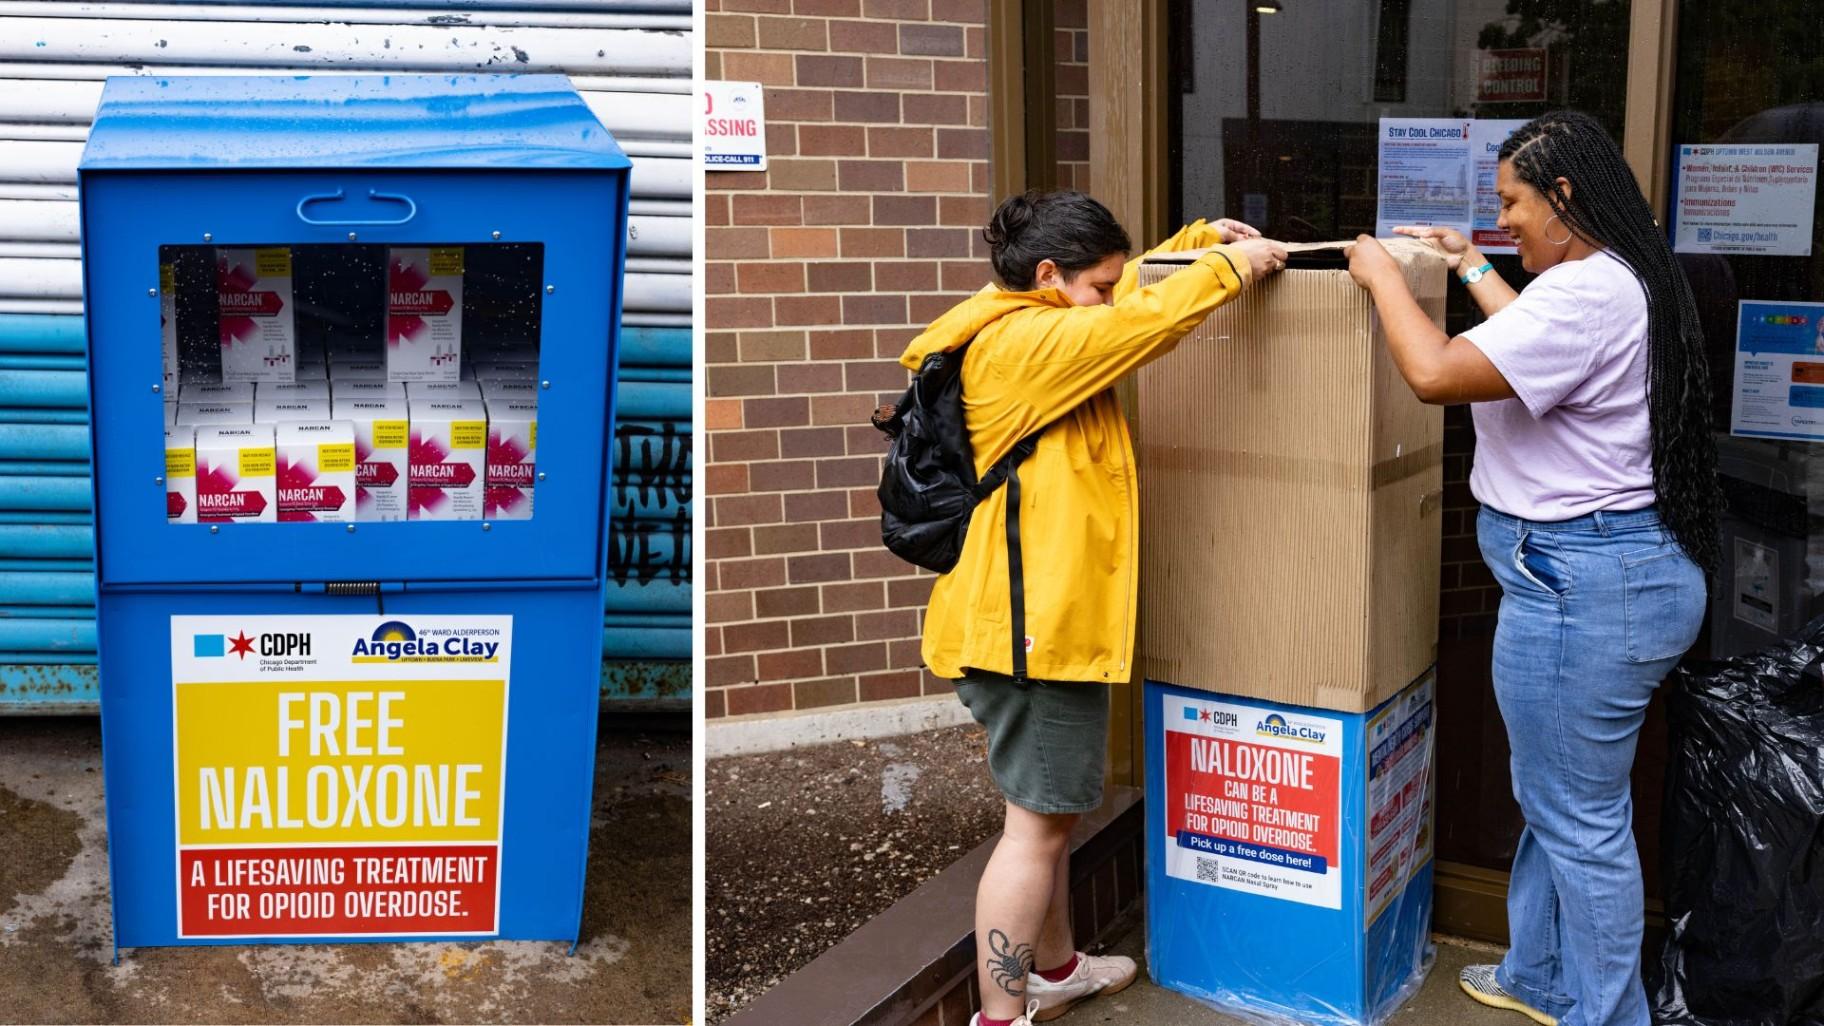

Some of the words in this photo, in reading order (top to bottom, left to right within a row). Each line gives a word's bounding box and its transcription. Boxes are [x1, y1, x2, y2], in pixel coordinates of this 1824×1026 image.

[1483, 57, 1541, 73] BLEEDING
[1483, 78, 1538, 95] CONTROL
[705, 119, 757, 136] SSING
[1786, 165, 1814, 174] Services
[1684, 199, 1736, 207] Immunizations
[1713, 230, 1778, 242] Chicago.gov/health
[219, 293, 263, 306] NARCAN
[390, 292, 433, 305] NARCAN
[356, 464, 377, 477] CAN
[410, 464, 454, 477] NARCAN
[488, 464, 533, 478] NARCAN
[199, 493, 245, 507] NARCAN
[278, 488, 324, 502] NARCAN
[260, 632, 311, 657] CDPH
[352, 637, 439, 660] Angela
[443, 637, 499, 659] Clay
[278, 691, 406, 757] FREE
[1213, 710, 1238, 727] CDPH
[1256, 720, 1297, 737] Angela
[1299, 726, 1326, 743] Clay
[1190, 737, 1314, 790] NALOXONE
[199, 764, 483, 830] NALOXONE
[1224, 780, 1248, 800] CAN
[1252, 785, 1267, 803] BE
[1269, 788, 1279, 805] A
[1184, 793, 1248, 820] LIFESAVING
[1251, 804, 1320, 832] TREATMENT
[1186, 812, 1208, 832] FOR
[1211, 817, 1249, 840] OPIOID
[1253, 825, 1317, 853] OVERDOSE.
[1190, 836, 1212, 850] Pick
[1214, 842, 1227, 854] up
[1229, 845, 1235, 854] a
[1237, 844, 1257, 858] free
[1259, 848, 1284, 863] dose
[1286, 852, 1312, 869] here!
[191, 860, 206, 887] A
[215, 858, 345, 887] LIFESAVING
[353, 856, 488, 885] TREATMENT
[1222, 866, 1238, 875] SCAN
[1238, 868, 1247, 877] QR
[1248, 871, 1261, 880] code
[1261, 873, 1267, 881] to
[1268, 874, 1282, 884] learn
[1283, 878, 1295, 887] how
[1295, 880, 1301, 888] to
[1302, 882, 1313, 890] use
[1222, 874, 1245, 884] NARCAN
[1246, 878, 1262, 888] Nasal
[1262, 881, 1279, 891] Spray
[208, 893, 251, 920] FOR
[259, 891, 336, 920] OPIOID
[344, 890, 469, 918] OVERDOSE.
